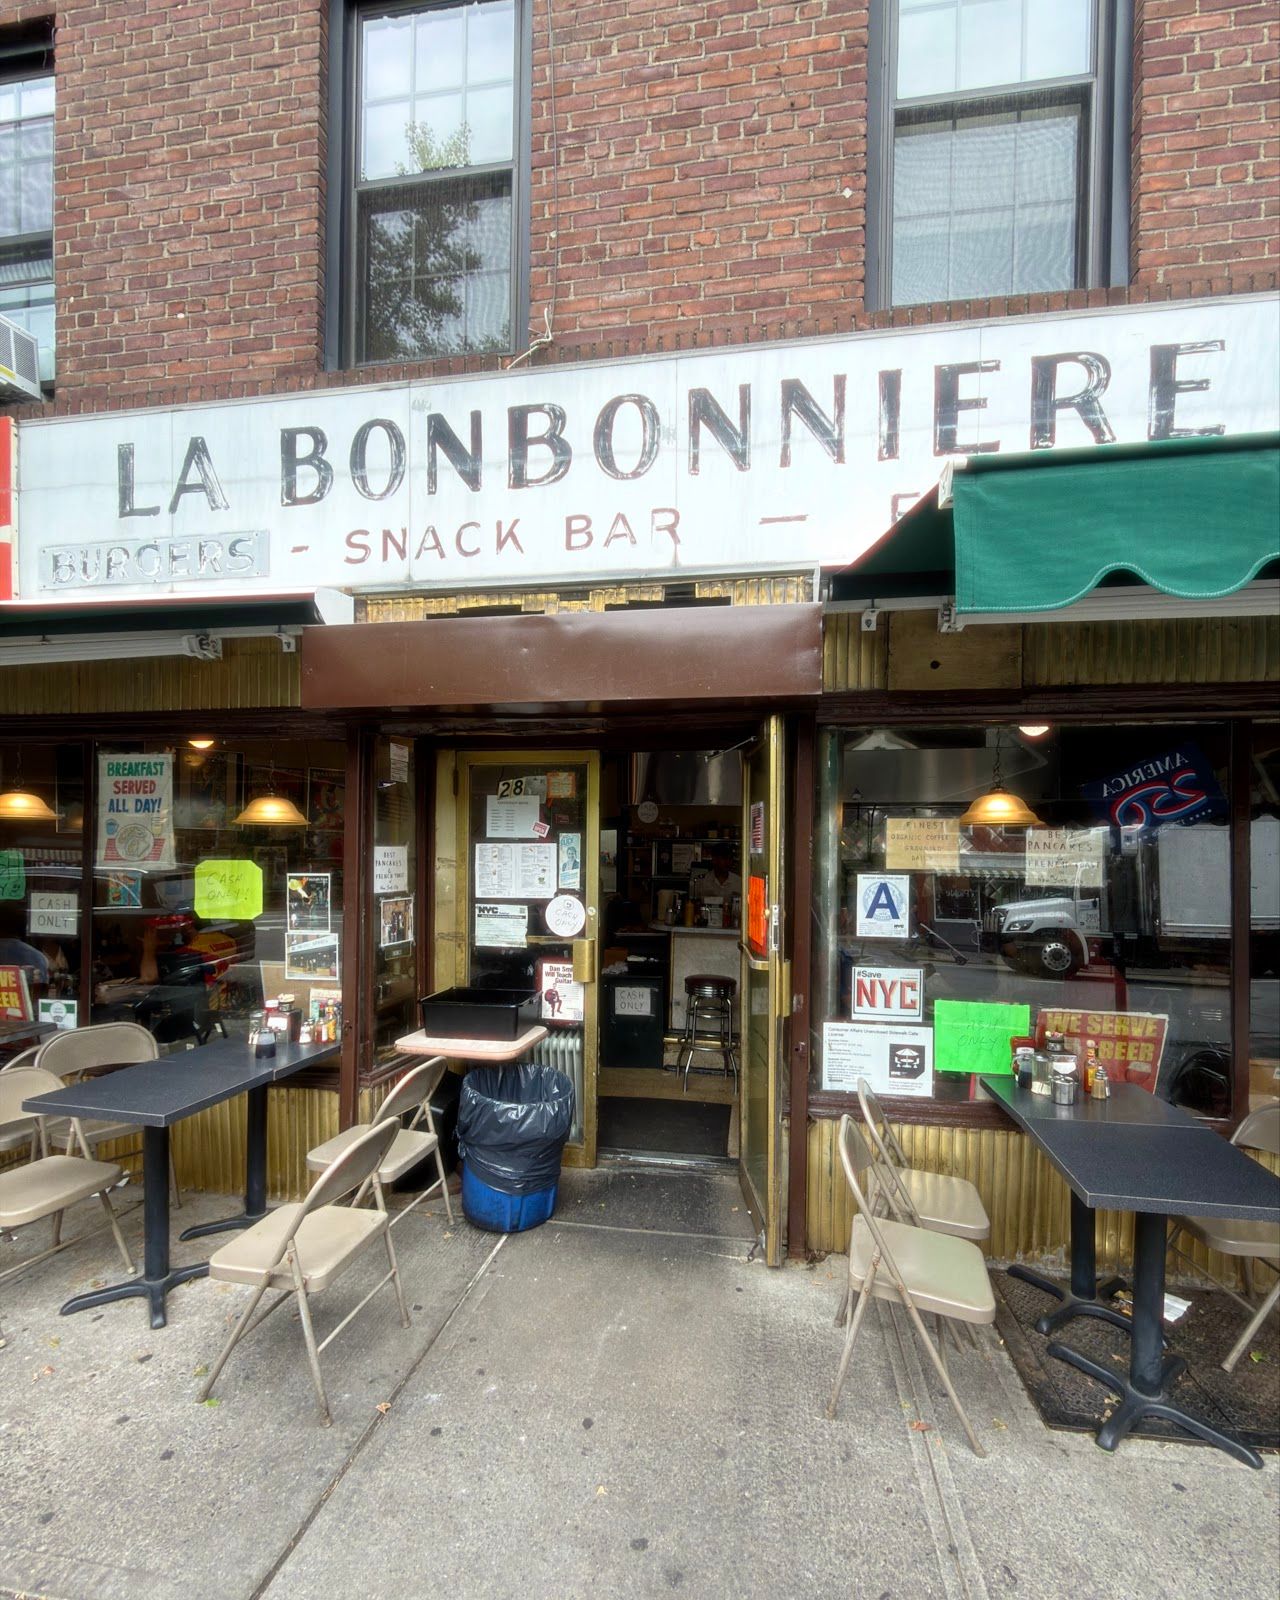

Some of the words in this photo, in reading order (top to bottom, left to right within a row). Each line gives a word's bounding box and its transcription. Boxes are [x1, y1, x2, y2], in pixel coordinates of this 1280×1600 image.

[117, 436, 230, 518] LA
[280, 339, 1225, 508] BONBONNIERE
[344, 518, 524, 564] SNACK
[564, 507, 681, 551] BAR
[52, 537, 255, 584] BURGERS
[107, 761, 165, 777] BREAKFAST
[113, 780, 157, 795] SERVED
[500, 779, 523, 798] 28
[108, 799, 129, 813] ALL
[134, 797, 162, 813] DAY!
[906, 821, 945, 829] FINEST
[207, 872, 245, 885] CASH
[38, 898, 71, 910] CASH
[865, 882, 900, 919] A
[478, 906, 498, 914] NYC
[37, 915, 69, 928] ONLY
[857, 970, 881, 979] #Save
[619, 990, 644, 1000] CASH
[856, 979, 917, 1009] NYC
[620, 1001, 645, 1010] ONLY
[1046, 1012, 1082, 1033] WE
[1087, 1014, 1158, 1037] SERVE
[1099, 1039, 1155, 1062] BEER
